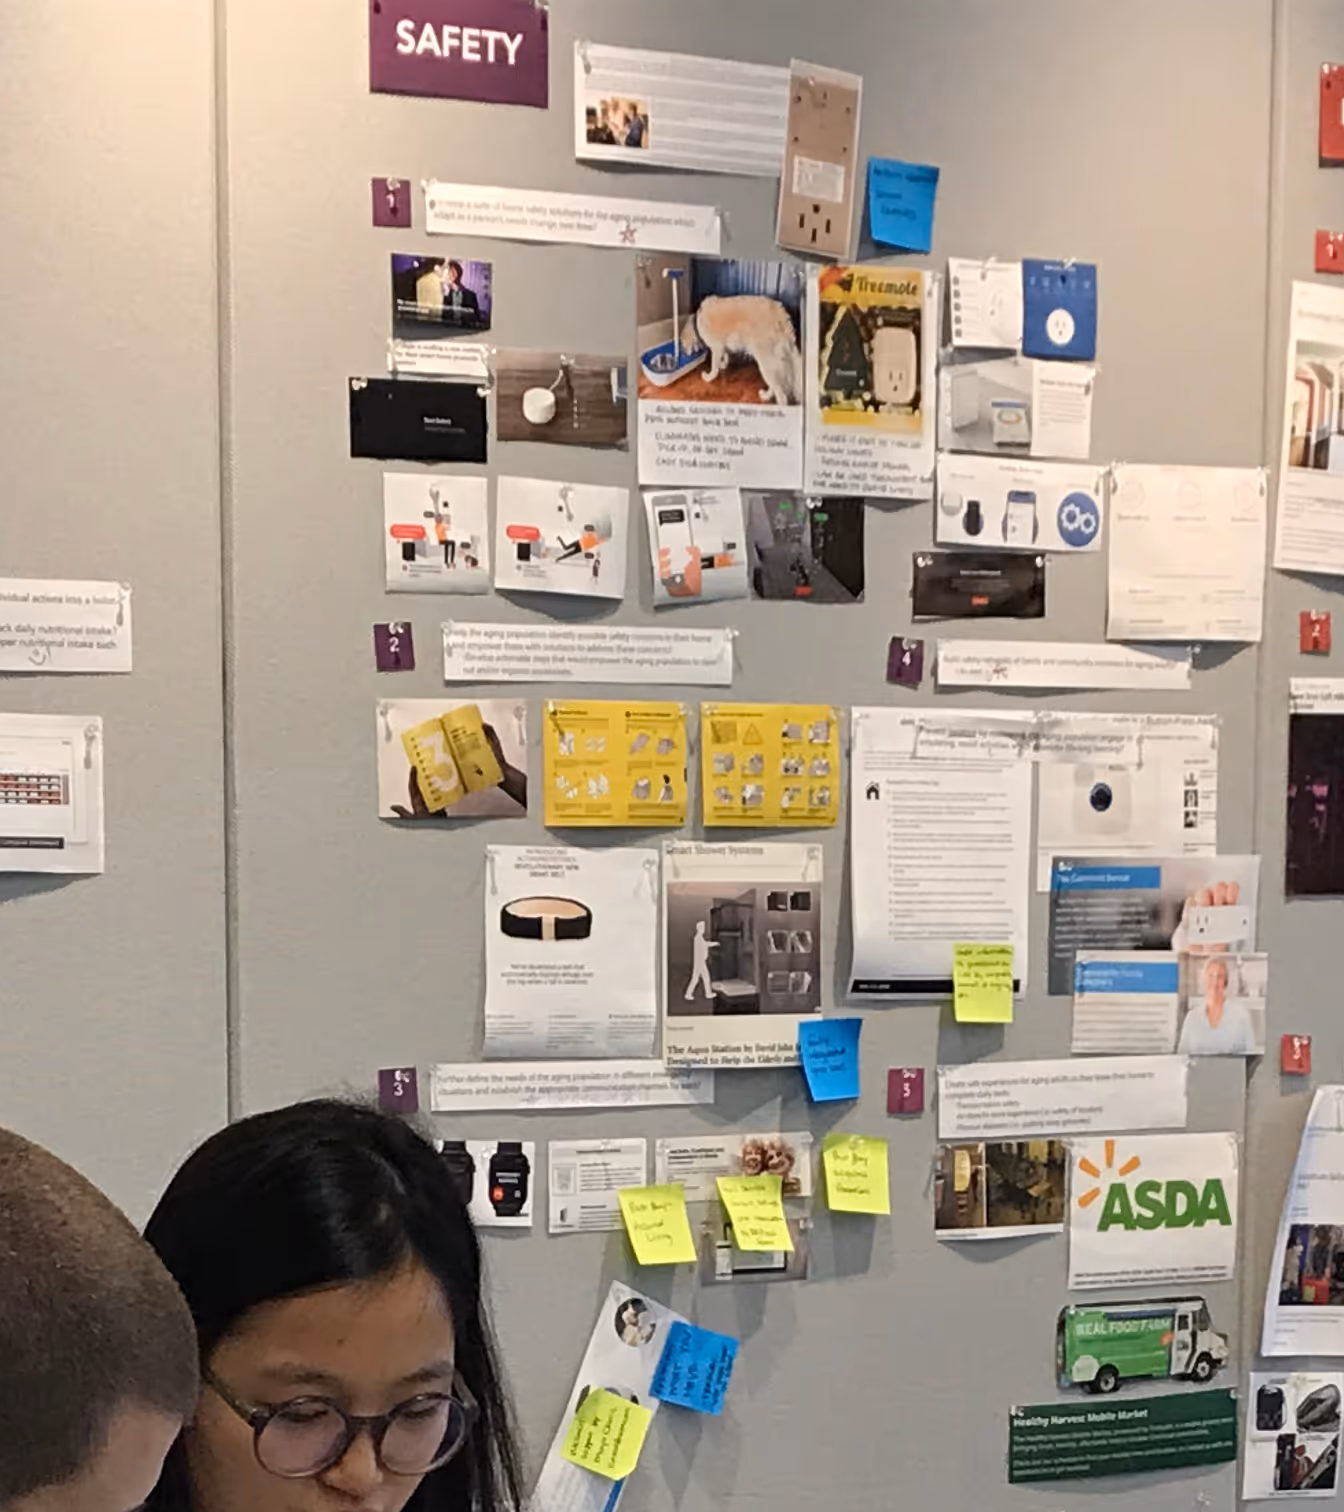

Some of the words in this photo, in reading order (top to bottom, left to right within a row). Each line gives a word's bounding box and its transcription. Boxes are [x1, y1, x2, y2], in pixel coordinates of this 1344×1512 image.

[396, 19, 525, 65] SAFETY
[32, 594, 63, 604] actions
[65, 595, 83, 605] into
[85, 597, 90, 605] a
[15, 623, 36, 635] daily
[38, 624, 84, 635] nutritional
[18, 638, 65, 649] nutritional
[67, 639, 94, 650] intake
[96, 640, 117, 650] such
[388, 637, 400, 653] 2
[393, 1081, 404, 1098] 3
[1097, 1179, 1232, 1232] ASDA
[1013, 1416, 1049, 1428] Healthy
[1051, 1414, 1085, 1425] Harvest
[1087, 1411, 1116, 1422] Mobile
[1118, 1408, 1148, 1420] Market
